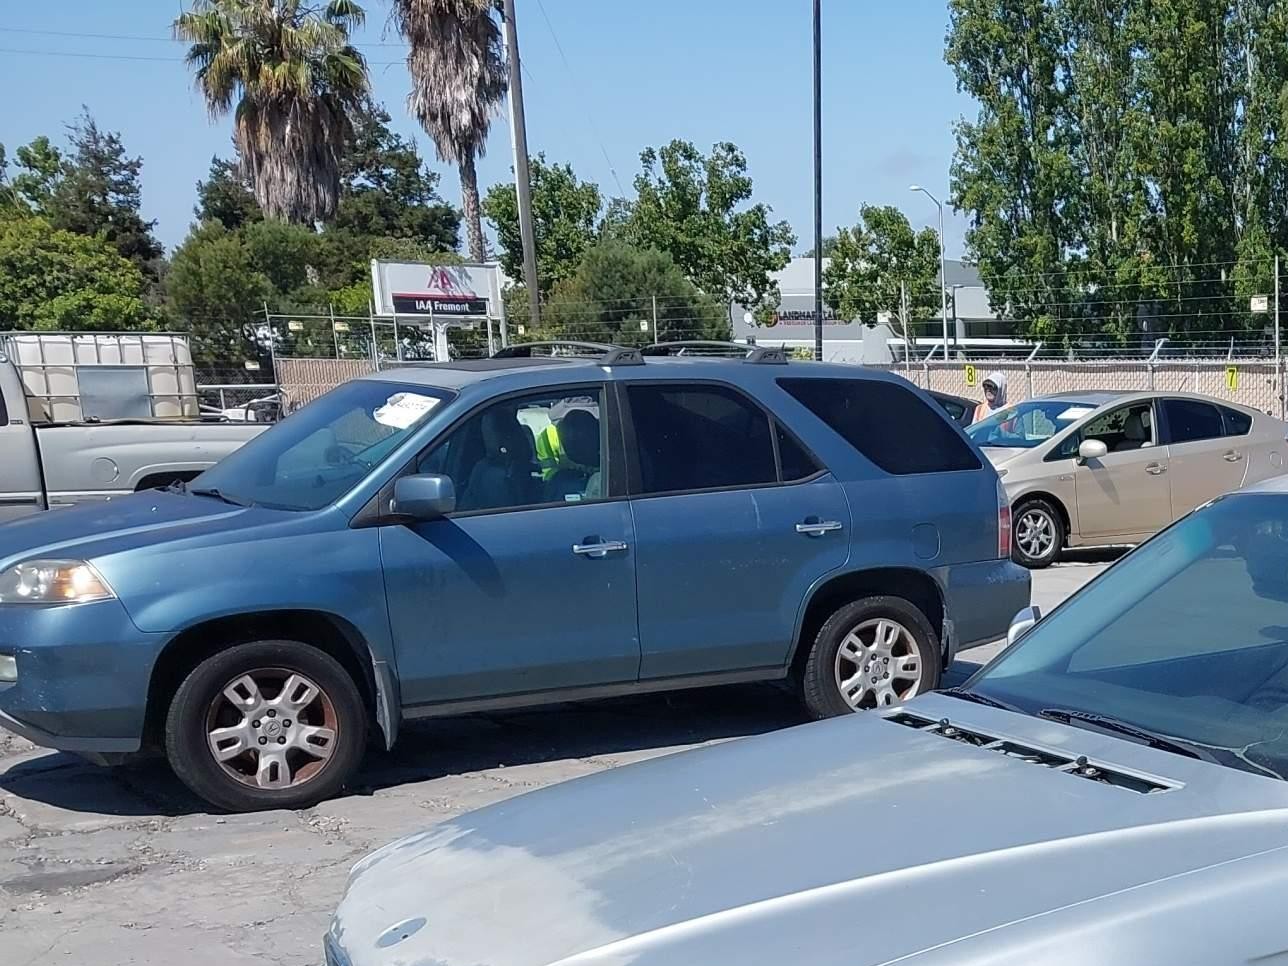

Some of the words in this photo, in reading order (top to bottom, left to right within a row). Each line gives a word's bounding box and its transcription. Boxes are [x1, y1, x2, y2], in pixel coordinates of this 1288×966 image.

[415, 300, 432, 311] IAA
[434, 301, 470, 312] Fremont
[967, 367, 974, 383] 8
[1228, 368, 1236, 387] 7
